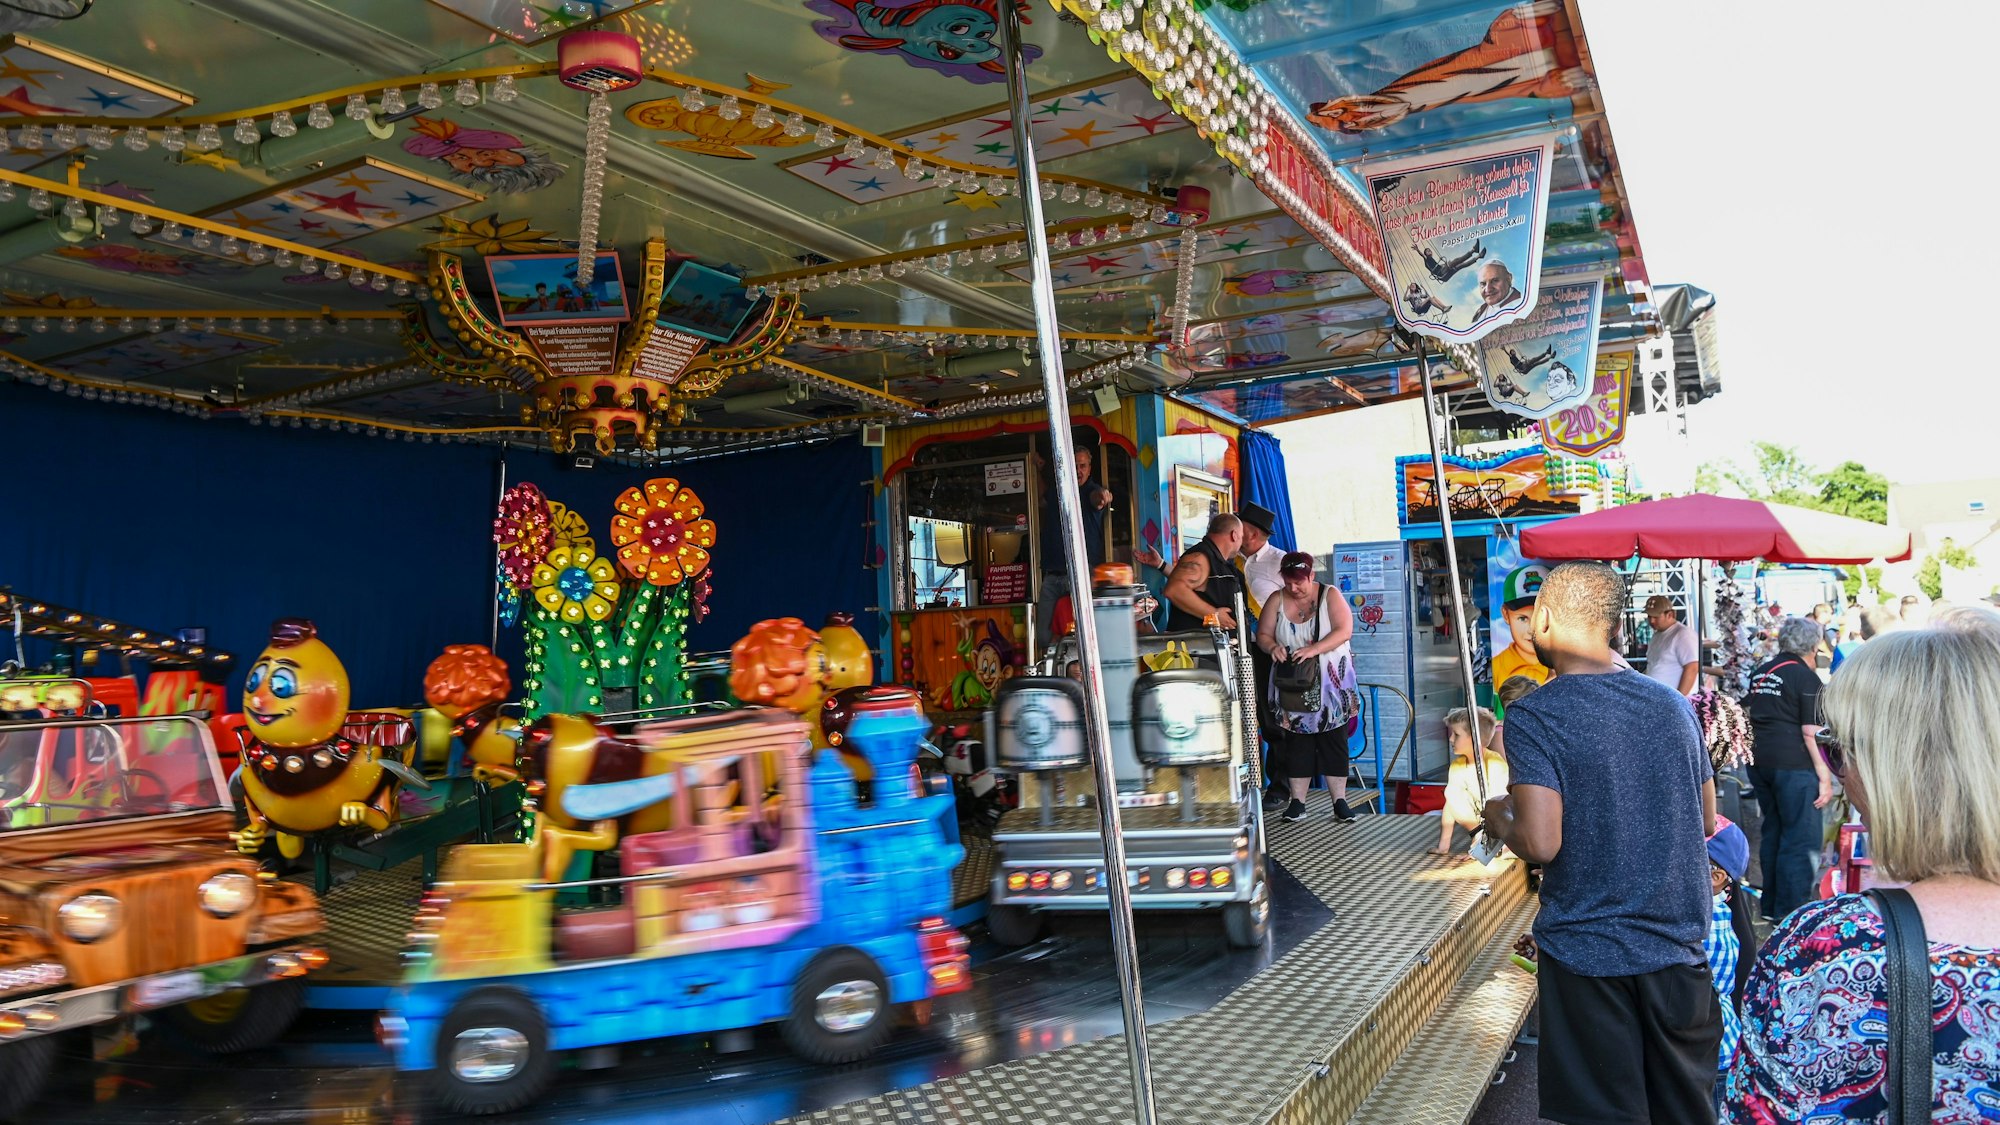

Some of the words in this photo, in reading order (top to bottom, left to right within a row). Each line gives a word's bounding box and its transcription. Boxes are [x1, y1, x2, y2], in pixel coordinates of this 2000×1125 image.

[1381, 194, 1394, 213] Es
[1396, 194, 1406, 208] ist
[1408, 188, 1424, 204] kein
[1426, 173, 1473, 199] Blumenbeet
[1475, 174, 1484, 192] zu
[1384, 214, 1402, 232] dass
[1404, 212, 1418, 226] man
[1421, 202, 1439, 221] nicht
[1441, 194, 1464, 217] darauf
[1467, 196, 1478, 208] ein
[1479, 179, 1518, 205] Karussell
[1519, 176, 1530, 198] für
[1411, 222, 1447, 244] Kinder
[1450, 217, 1476, 233] bauen
[1476, 201, 1508, 224] könnte!
[1441, 235, 1464, 248] Papst
[1465, 222, 1504, 241] Johannes
[1506, 214, 1526, 227] XXIII
[529, 328, 538, 336] Bei
[538, 327, 556, 337] Signal
[556, 326, 581, 335] Fahrbahn
[581, 325, 614, 334] freimachen!
[664, 330, 675, 338] für
[675, 332, 701, 345] Kinder!
[990, 565, 1024, 573] FAHRPREIS
